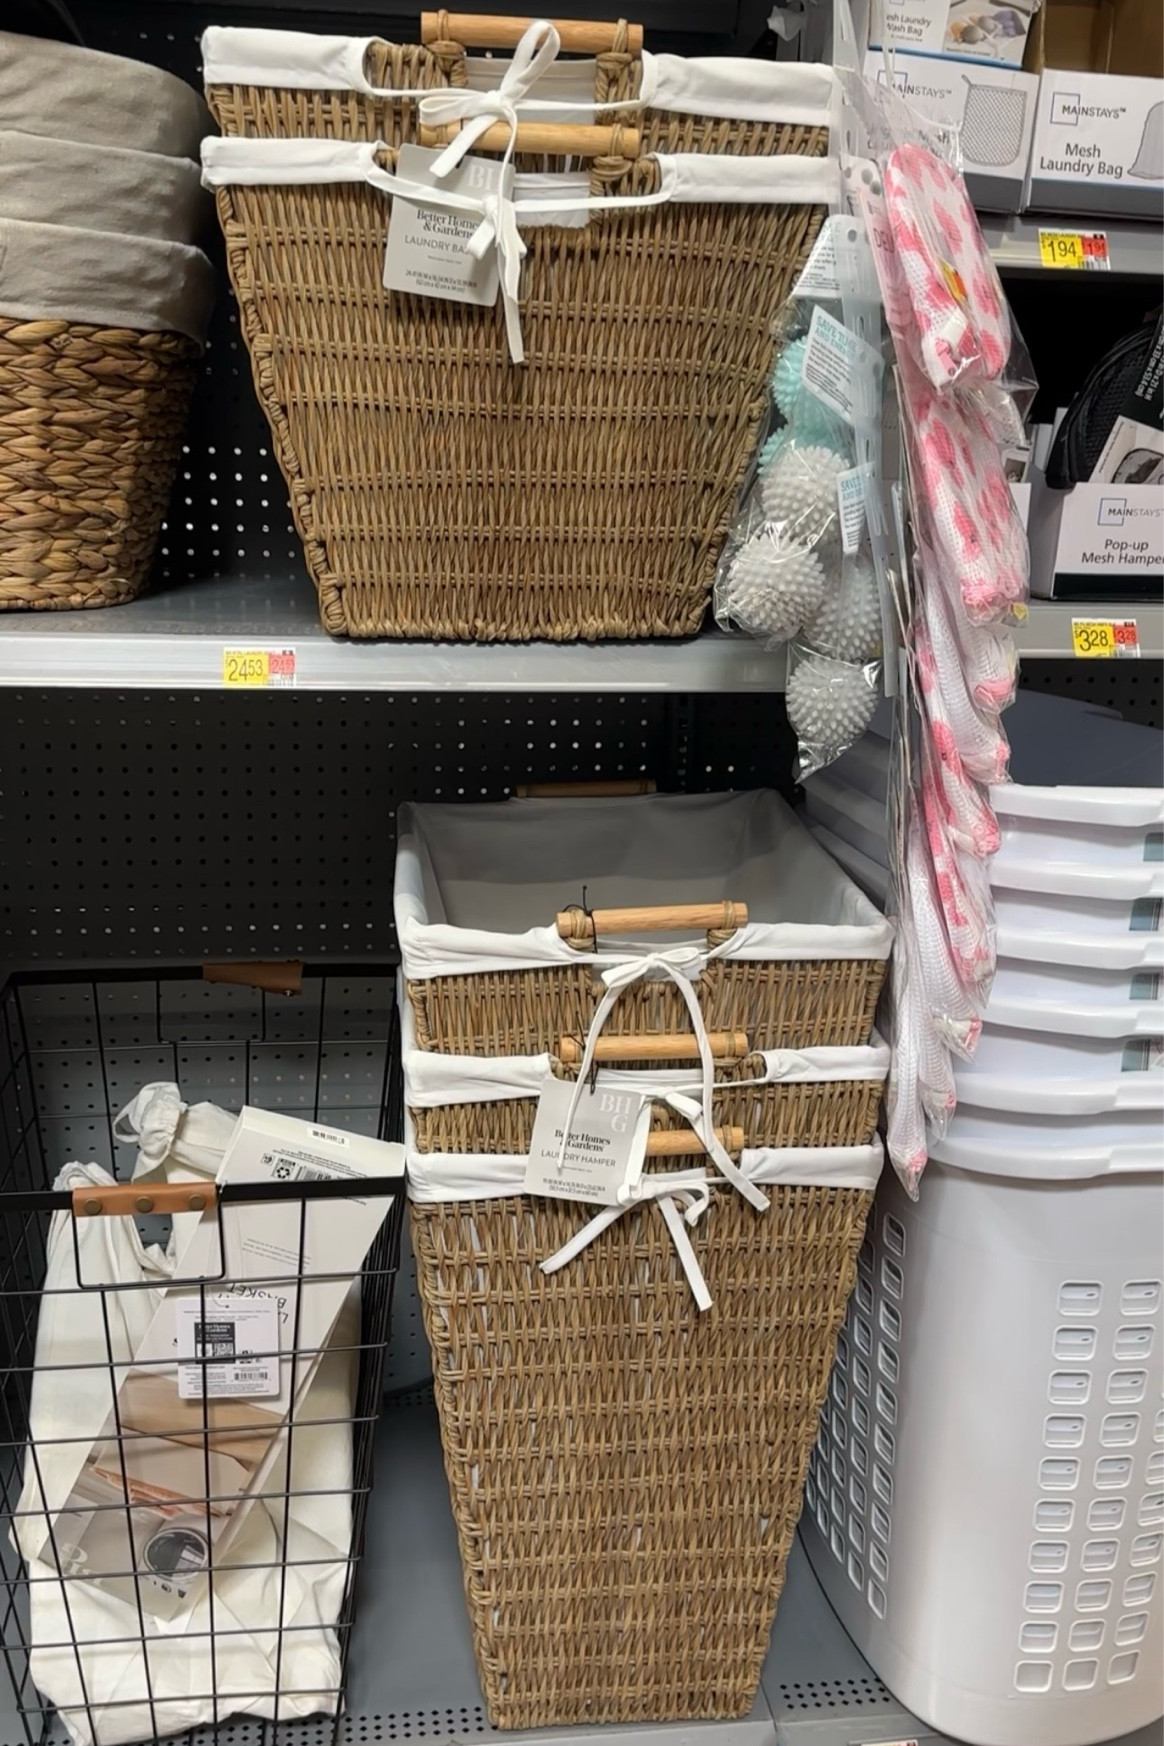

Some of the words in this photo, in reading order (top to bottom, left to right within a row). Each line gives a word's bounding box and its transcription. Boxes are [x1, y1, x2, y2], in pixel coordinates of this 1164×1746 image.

[887, 13, 899, 22] esh
[901, 14, 931, 28] Laundry
[908, 25, 923, 37] Bag
[1064, 142, 1101, 159] Mesh
[1039, 156, 1095, 177] Laundry
[1097, 160, 1124, 179] Bag
[416, 209, 448, 224] Better
[423, 222, 433, 232] &
[404, 234, 451, 252] LAUNDRY
[814, 315, 840, 338] SAVE
[1104, 539, 1149, 553] Pop-up
[1081, 552, 1115, 564] Mesh
[555, 1129, 581, 1140] Beter
[581, 1133, 611, 1146] Homes
[567, 1140, 605, 1152] Gardens
[581, 1155, 617, 1168] HAMPER
[228, 1282, 288, 1309] BSKET
